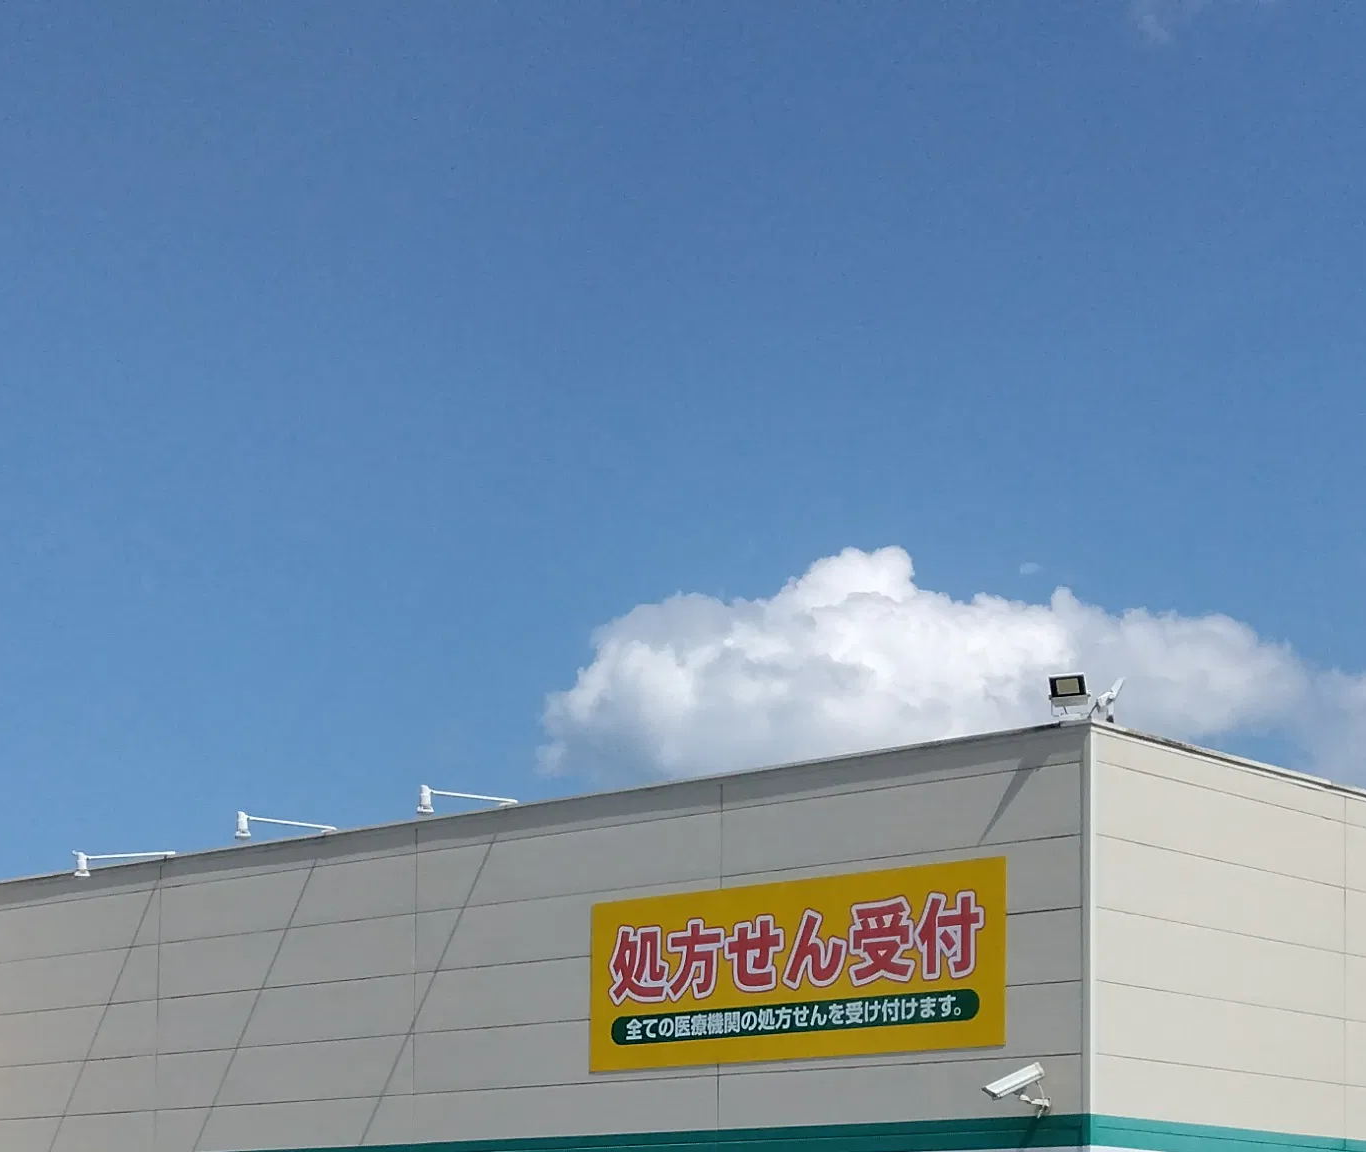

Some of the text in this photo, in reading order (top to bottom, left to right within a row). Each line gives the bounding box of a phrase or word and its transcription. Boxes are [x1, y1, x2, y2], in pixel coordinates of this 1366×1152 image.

[608, 889, 985, 1005] 処方せん受付
[626, 995, 962, 1041] 全ての医療機関の処方せんを受け付けます。
